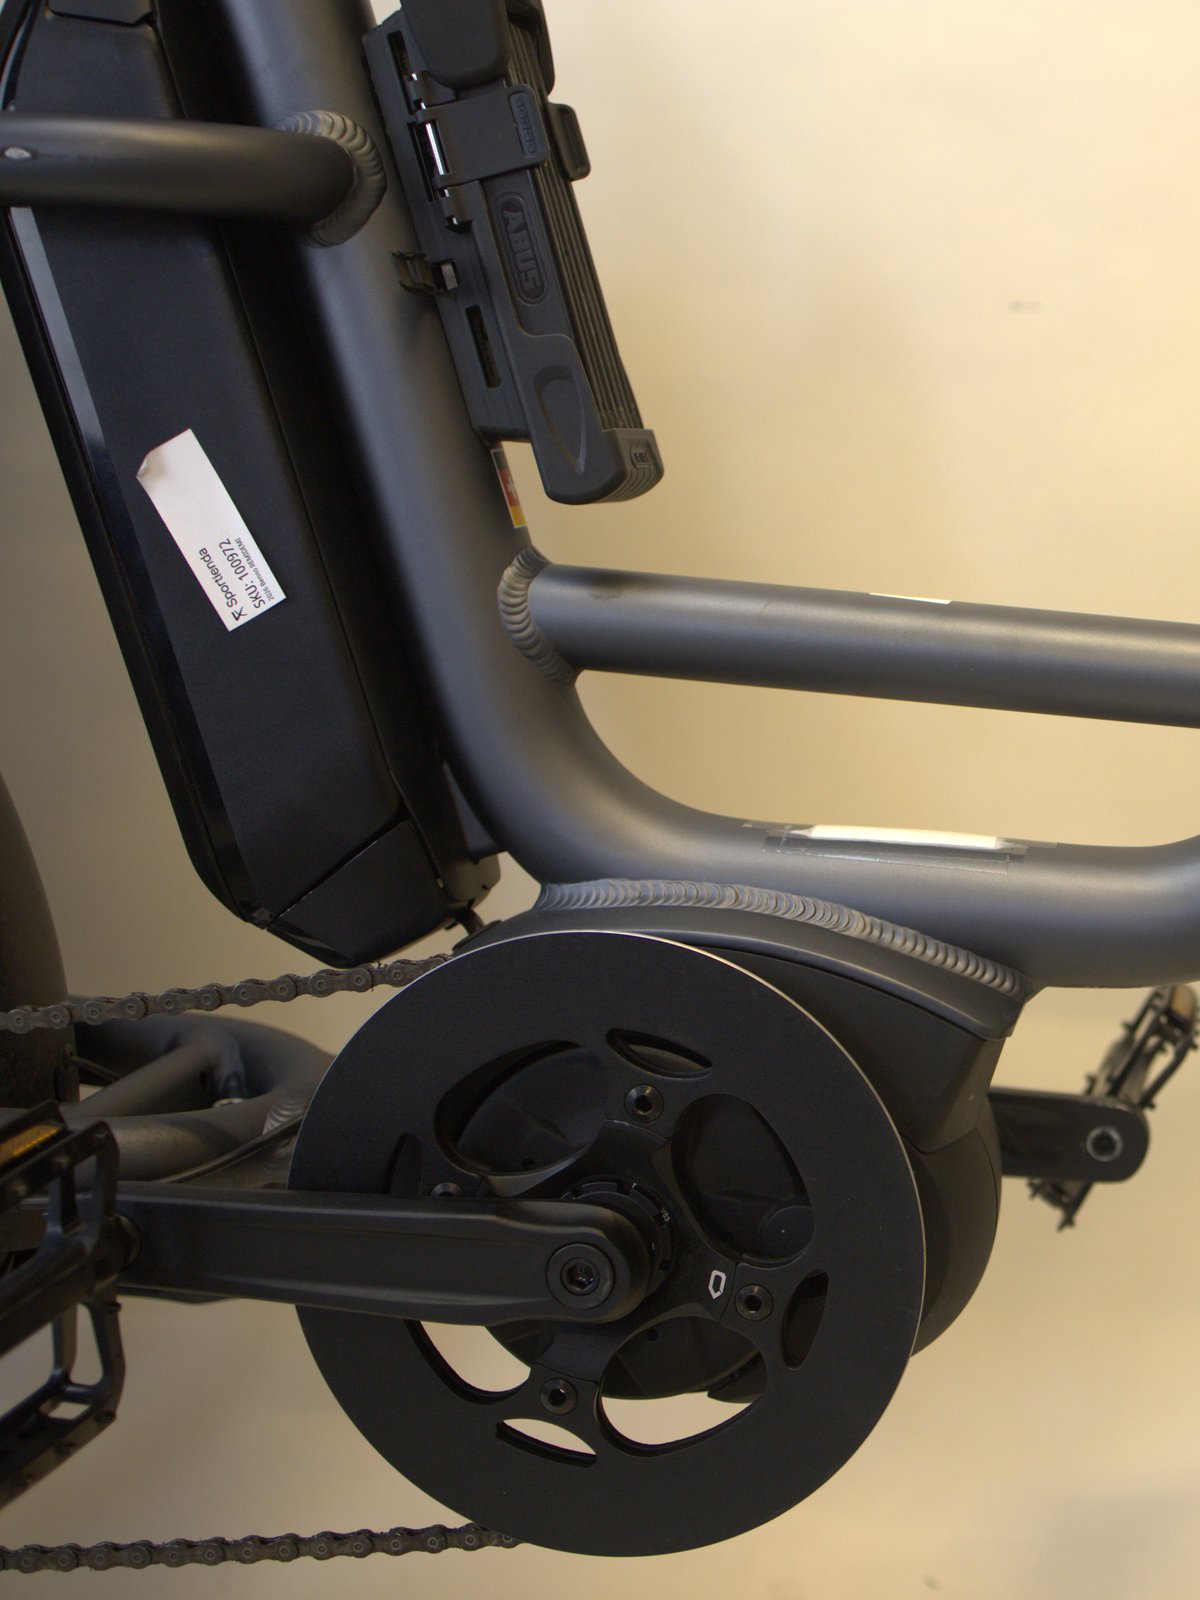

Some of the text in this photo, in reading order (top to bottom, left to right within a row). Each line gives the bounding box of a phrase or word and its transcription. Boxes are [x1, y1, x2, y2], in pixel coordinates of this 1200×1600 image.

[502, 209, 540, 290] ABUS
[199, 547, 238, 608] Sportienda
[219, 538, 266, 609] SKU: 100972
[234, 537, 275, 601] 2026 Benno REMIDEMI
